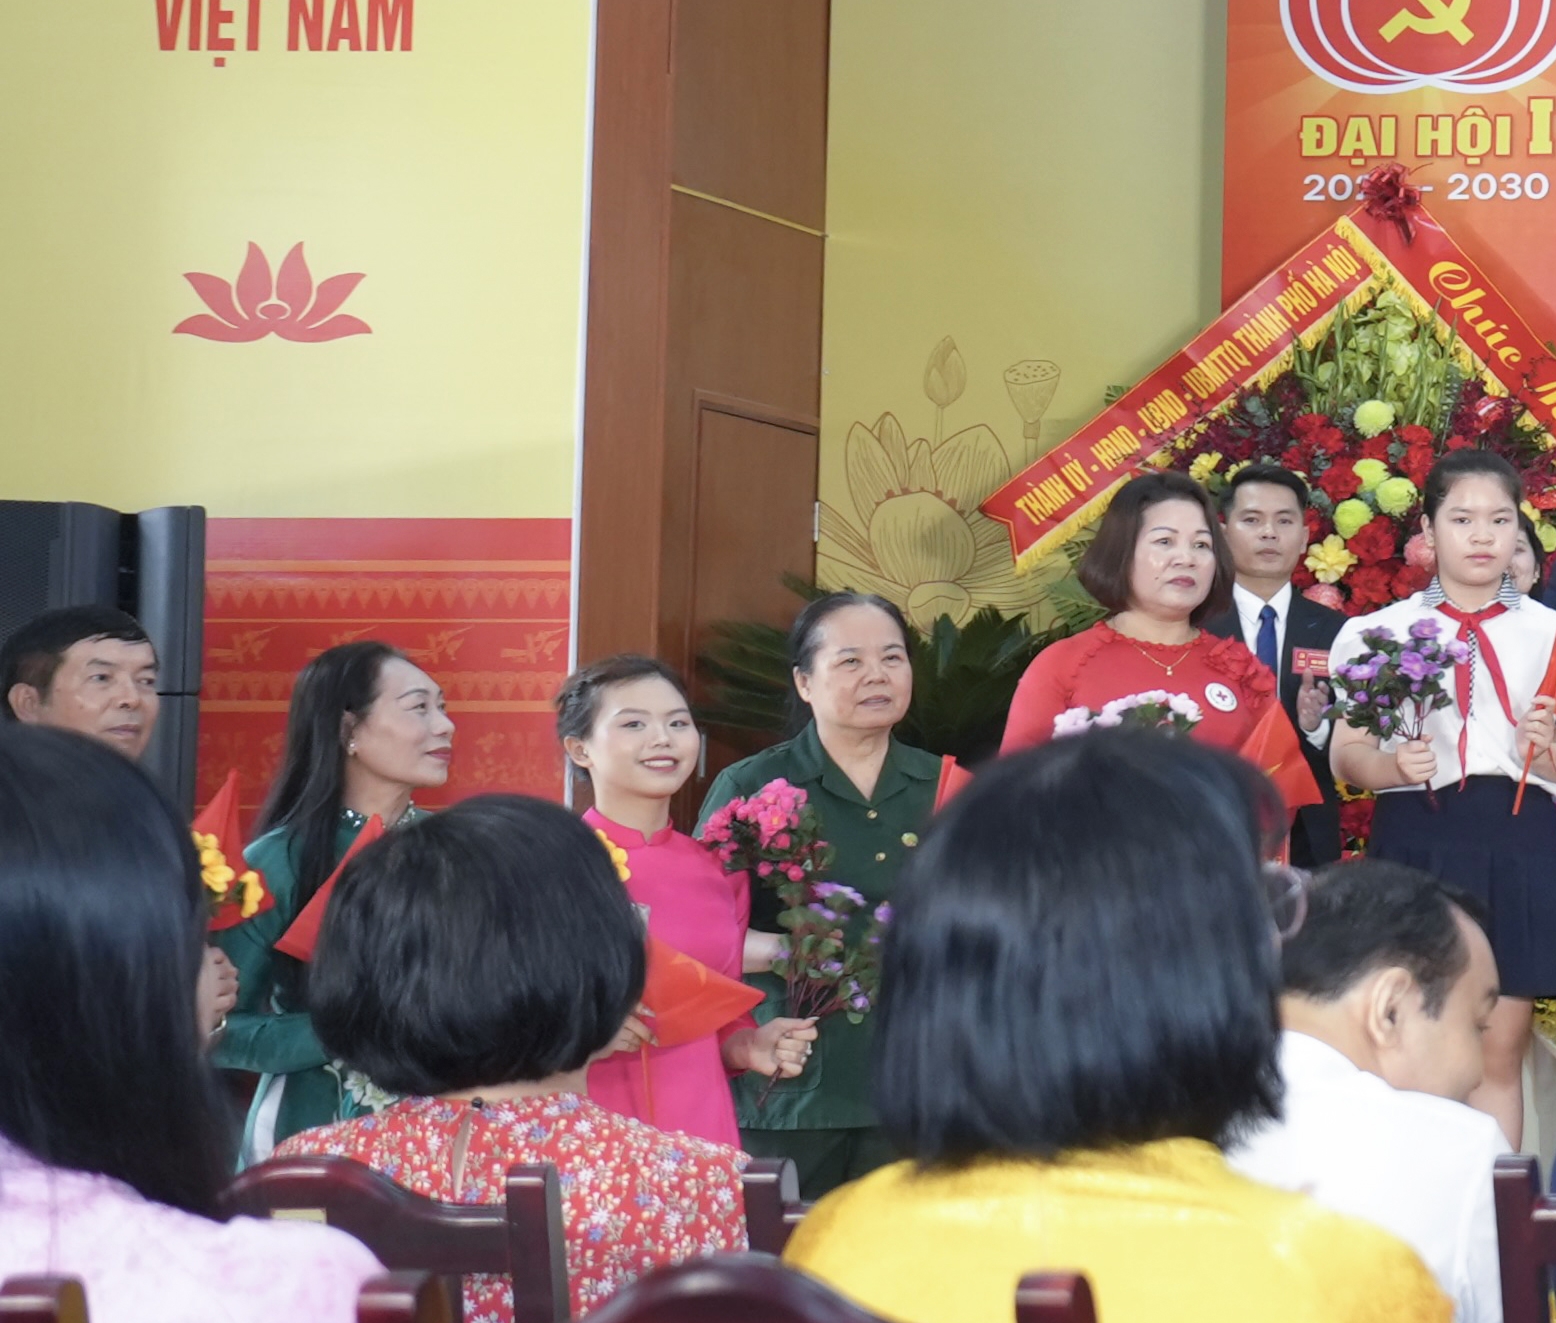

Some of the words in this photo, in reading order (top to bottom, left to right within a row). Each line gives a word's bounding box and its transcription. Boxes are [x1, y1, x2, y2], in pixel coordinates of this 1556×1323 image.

[1299, 114, 1398, 166] ĐẠI
[1416, 105, 1512, 166] HỘI
[1529, 96, 1556, 156] I
[1447, 172, 1550, 201] 2030
[1428, 259, 1522, 372] Chúc
[1013, 472, 1076, 526] THÀNH
[1181, 339, 1252, 400] UBMTTQ
[1232, 302, 1293, 357] THÀNH
[1274, 269, 1319, 323] PHỐ
[1301, 259, 1340, 300] HÀ
[1321, 243, 1362, 284] NỘI
